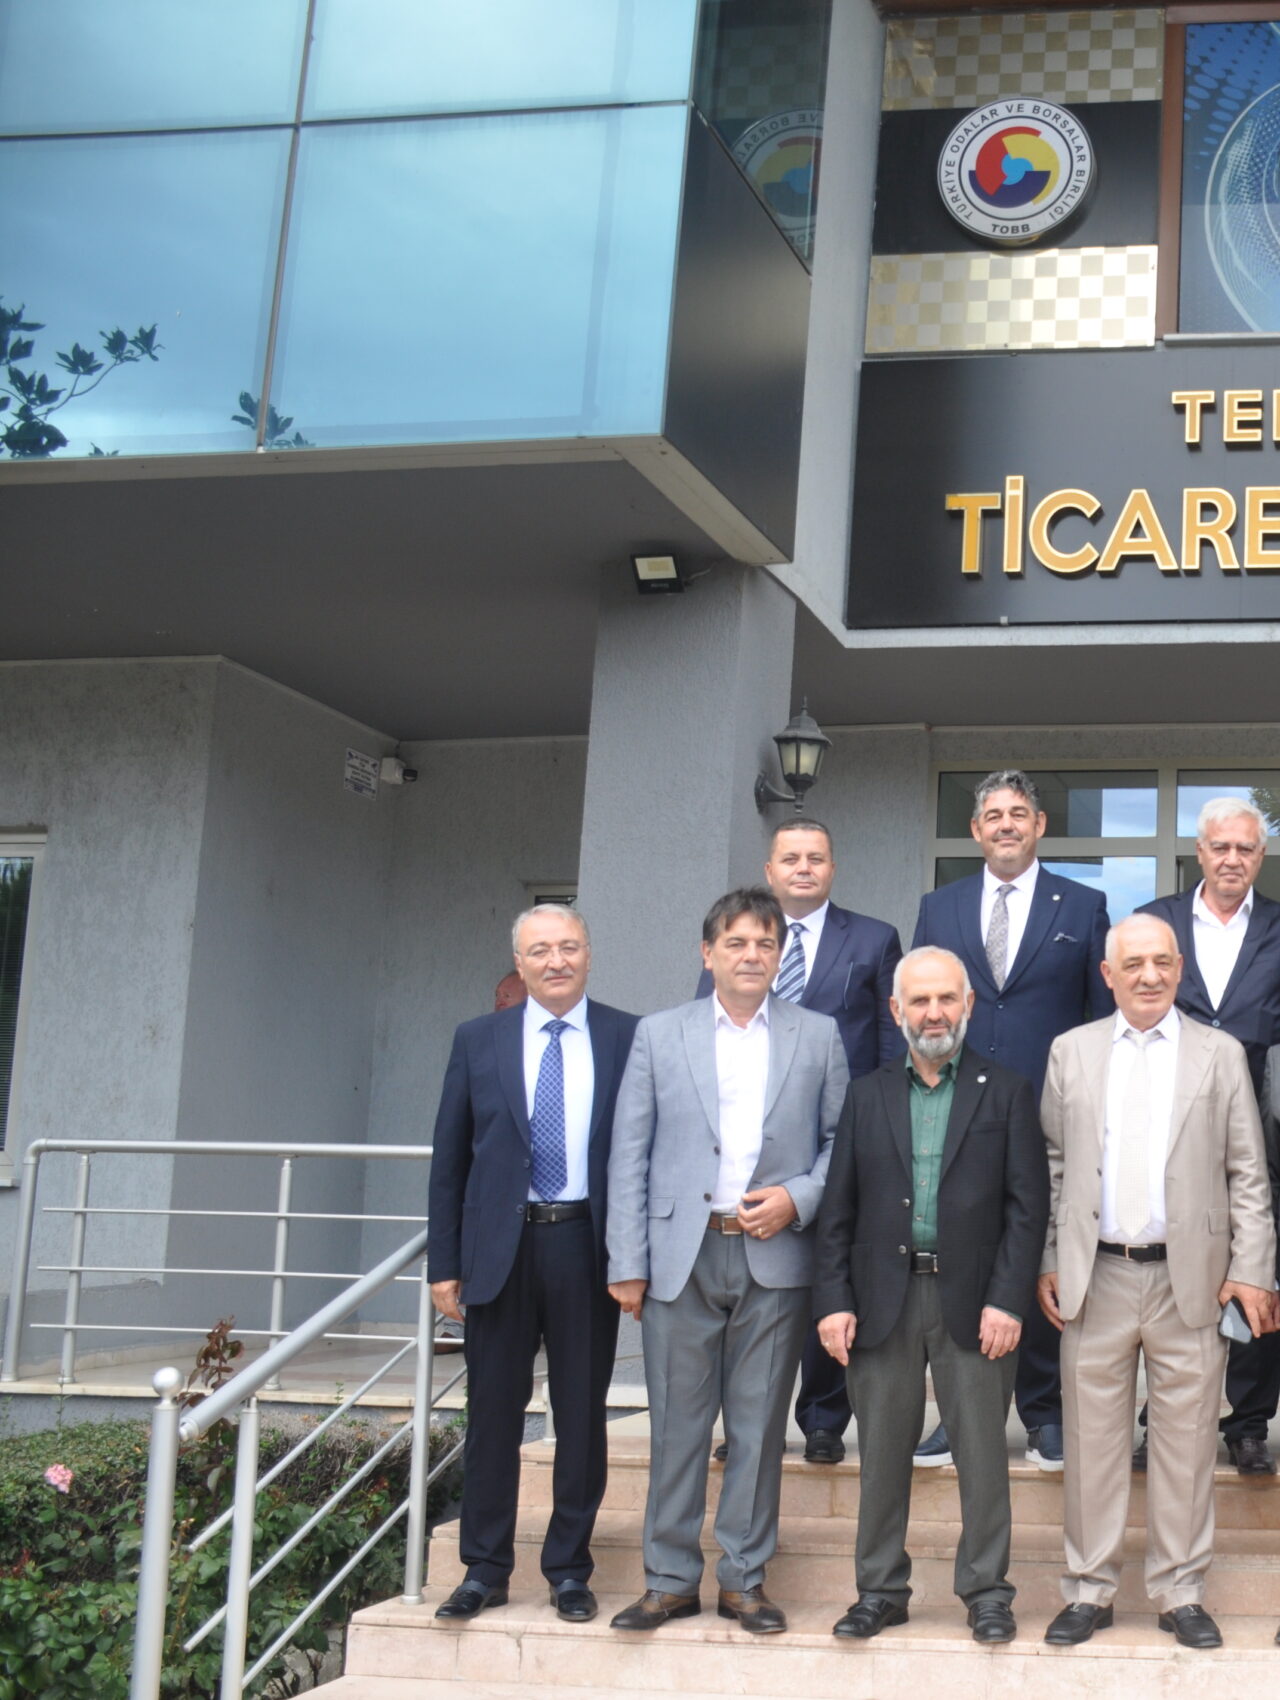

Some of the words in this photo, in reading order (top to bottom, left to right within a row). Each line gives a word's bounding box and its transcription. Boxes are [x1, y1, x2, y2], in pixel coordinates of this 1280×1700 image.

[950, 108, 999, 154] ODALAR
[1005, 103, 1025, 113] VE
[1032, 105, 1086, 162] BORSALAR
[991, 223, 1030, 234] TOBB
